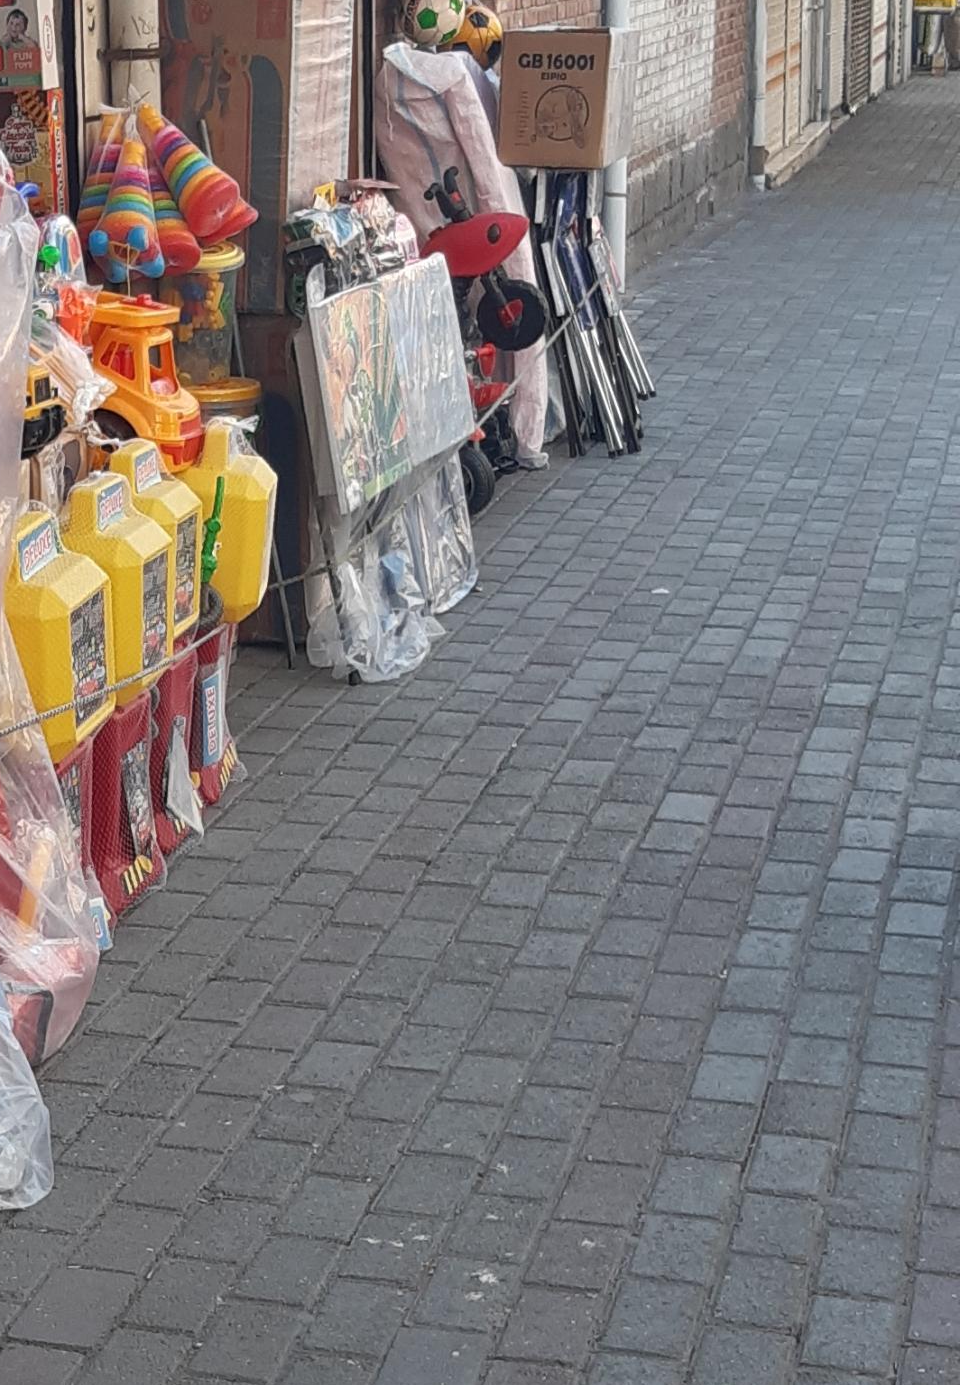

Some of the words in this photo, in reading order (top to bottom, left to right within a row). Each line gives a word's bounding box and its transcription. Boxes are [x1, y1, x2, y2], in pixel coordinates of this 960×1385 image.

[13, 50, 33, 61] FUN
[518, 53, 543, 68] GB
[546, 54, 595, 70] 16001
[100, 487, 124, 520] DELUXE
[23, 524, 52, 570] DELUXE
[206, 686, 218, 754] DELUXE
